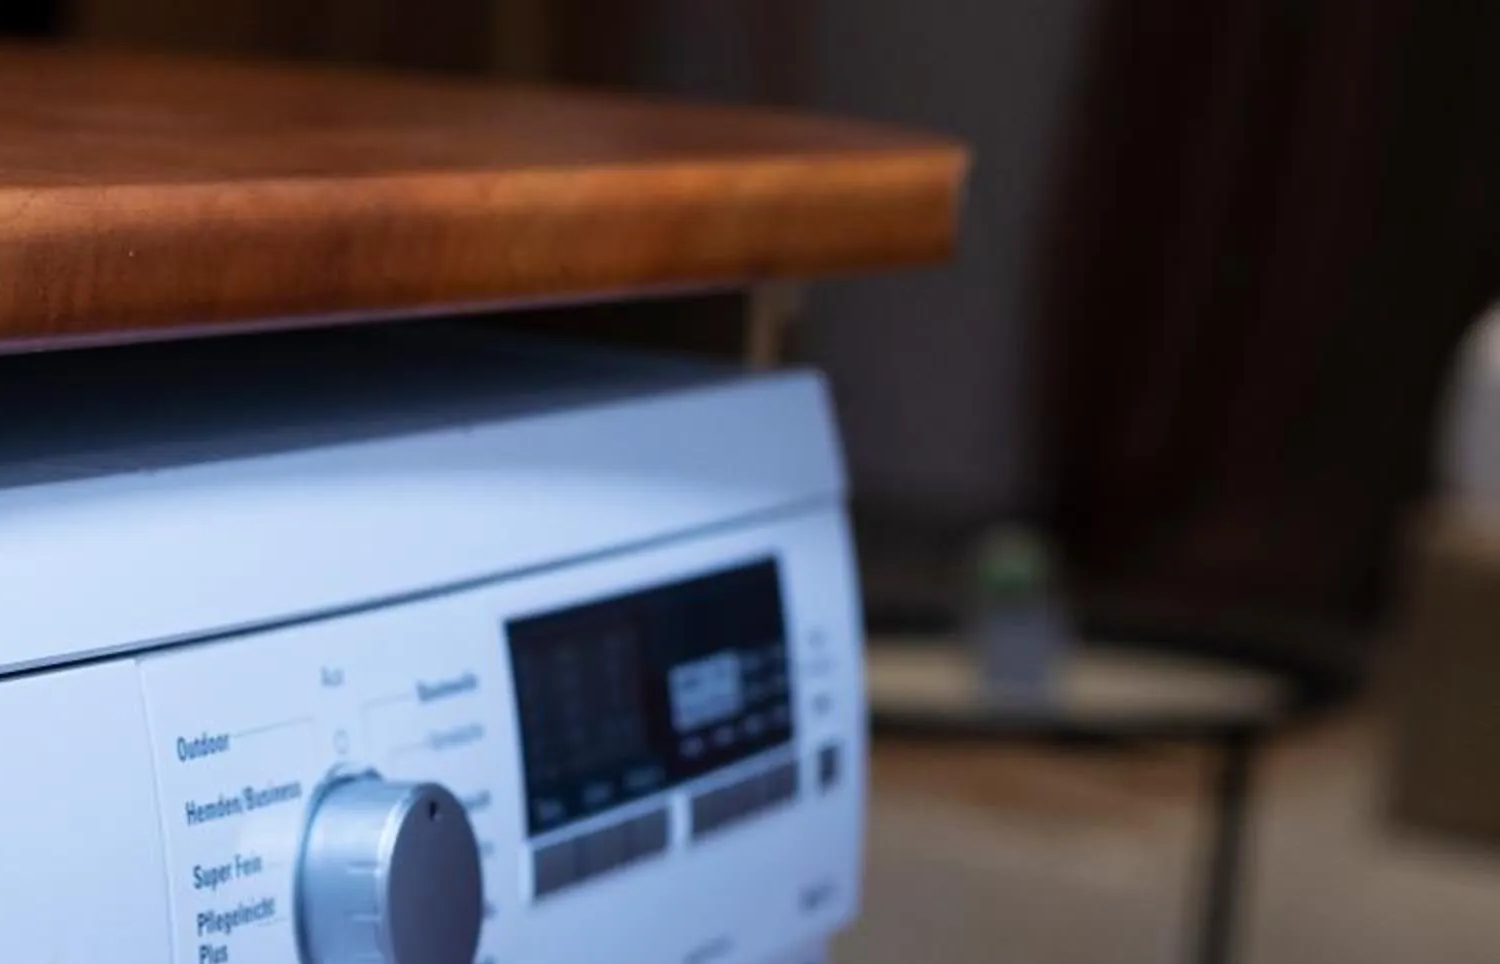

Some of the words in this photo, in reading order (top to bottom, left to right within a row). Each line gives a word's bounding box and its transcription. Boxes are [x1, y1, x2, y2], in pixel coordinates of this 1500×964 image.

[177, 732, 230, 762] Outdoor
[193, 863, 232, 891] Super
[235, 853, 263, 878] Fein
[197, 897, 276, 937] Pflegeleicht
